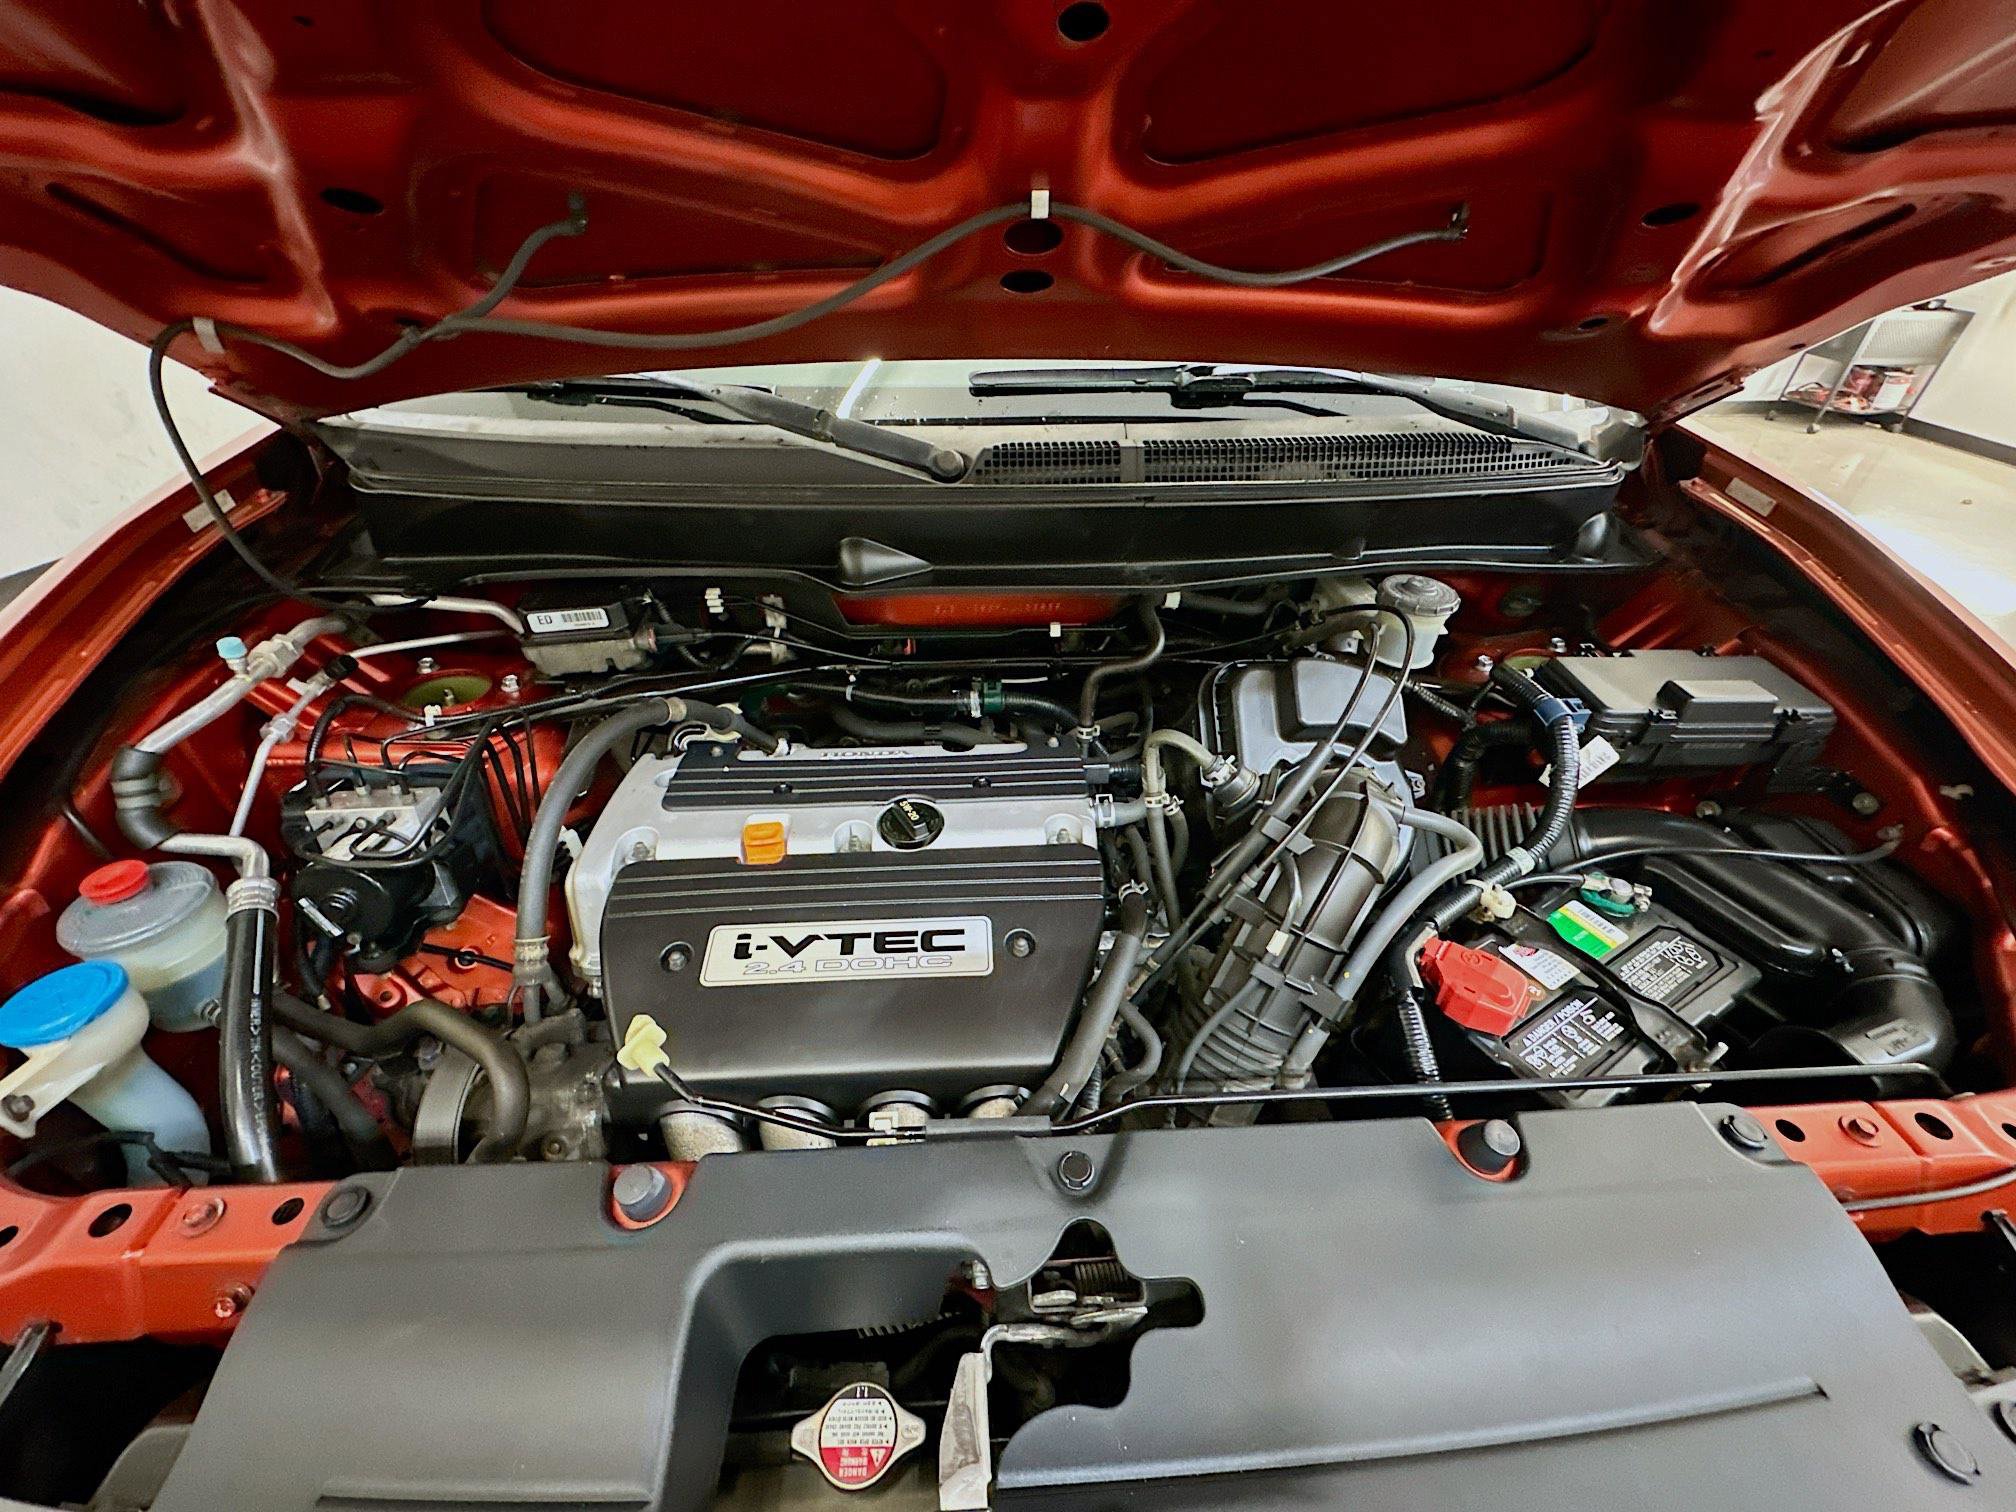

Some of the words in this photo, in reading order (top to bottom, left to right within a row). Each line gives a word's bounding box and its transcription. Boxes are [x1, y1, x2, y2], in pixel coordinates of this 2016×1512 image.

[821, 750, 909, 760] HONDA
[899, 800, 920, 821] 5W-20
[734, 929, 966, 959] i-VTEC
[743, 960, 806, 975] 2.4
[815, 955, 953, 972] DOHC
